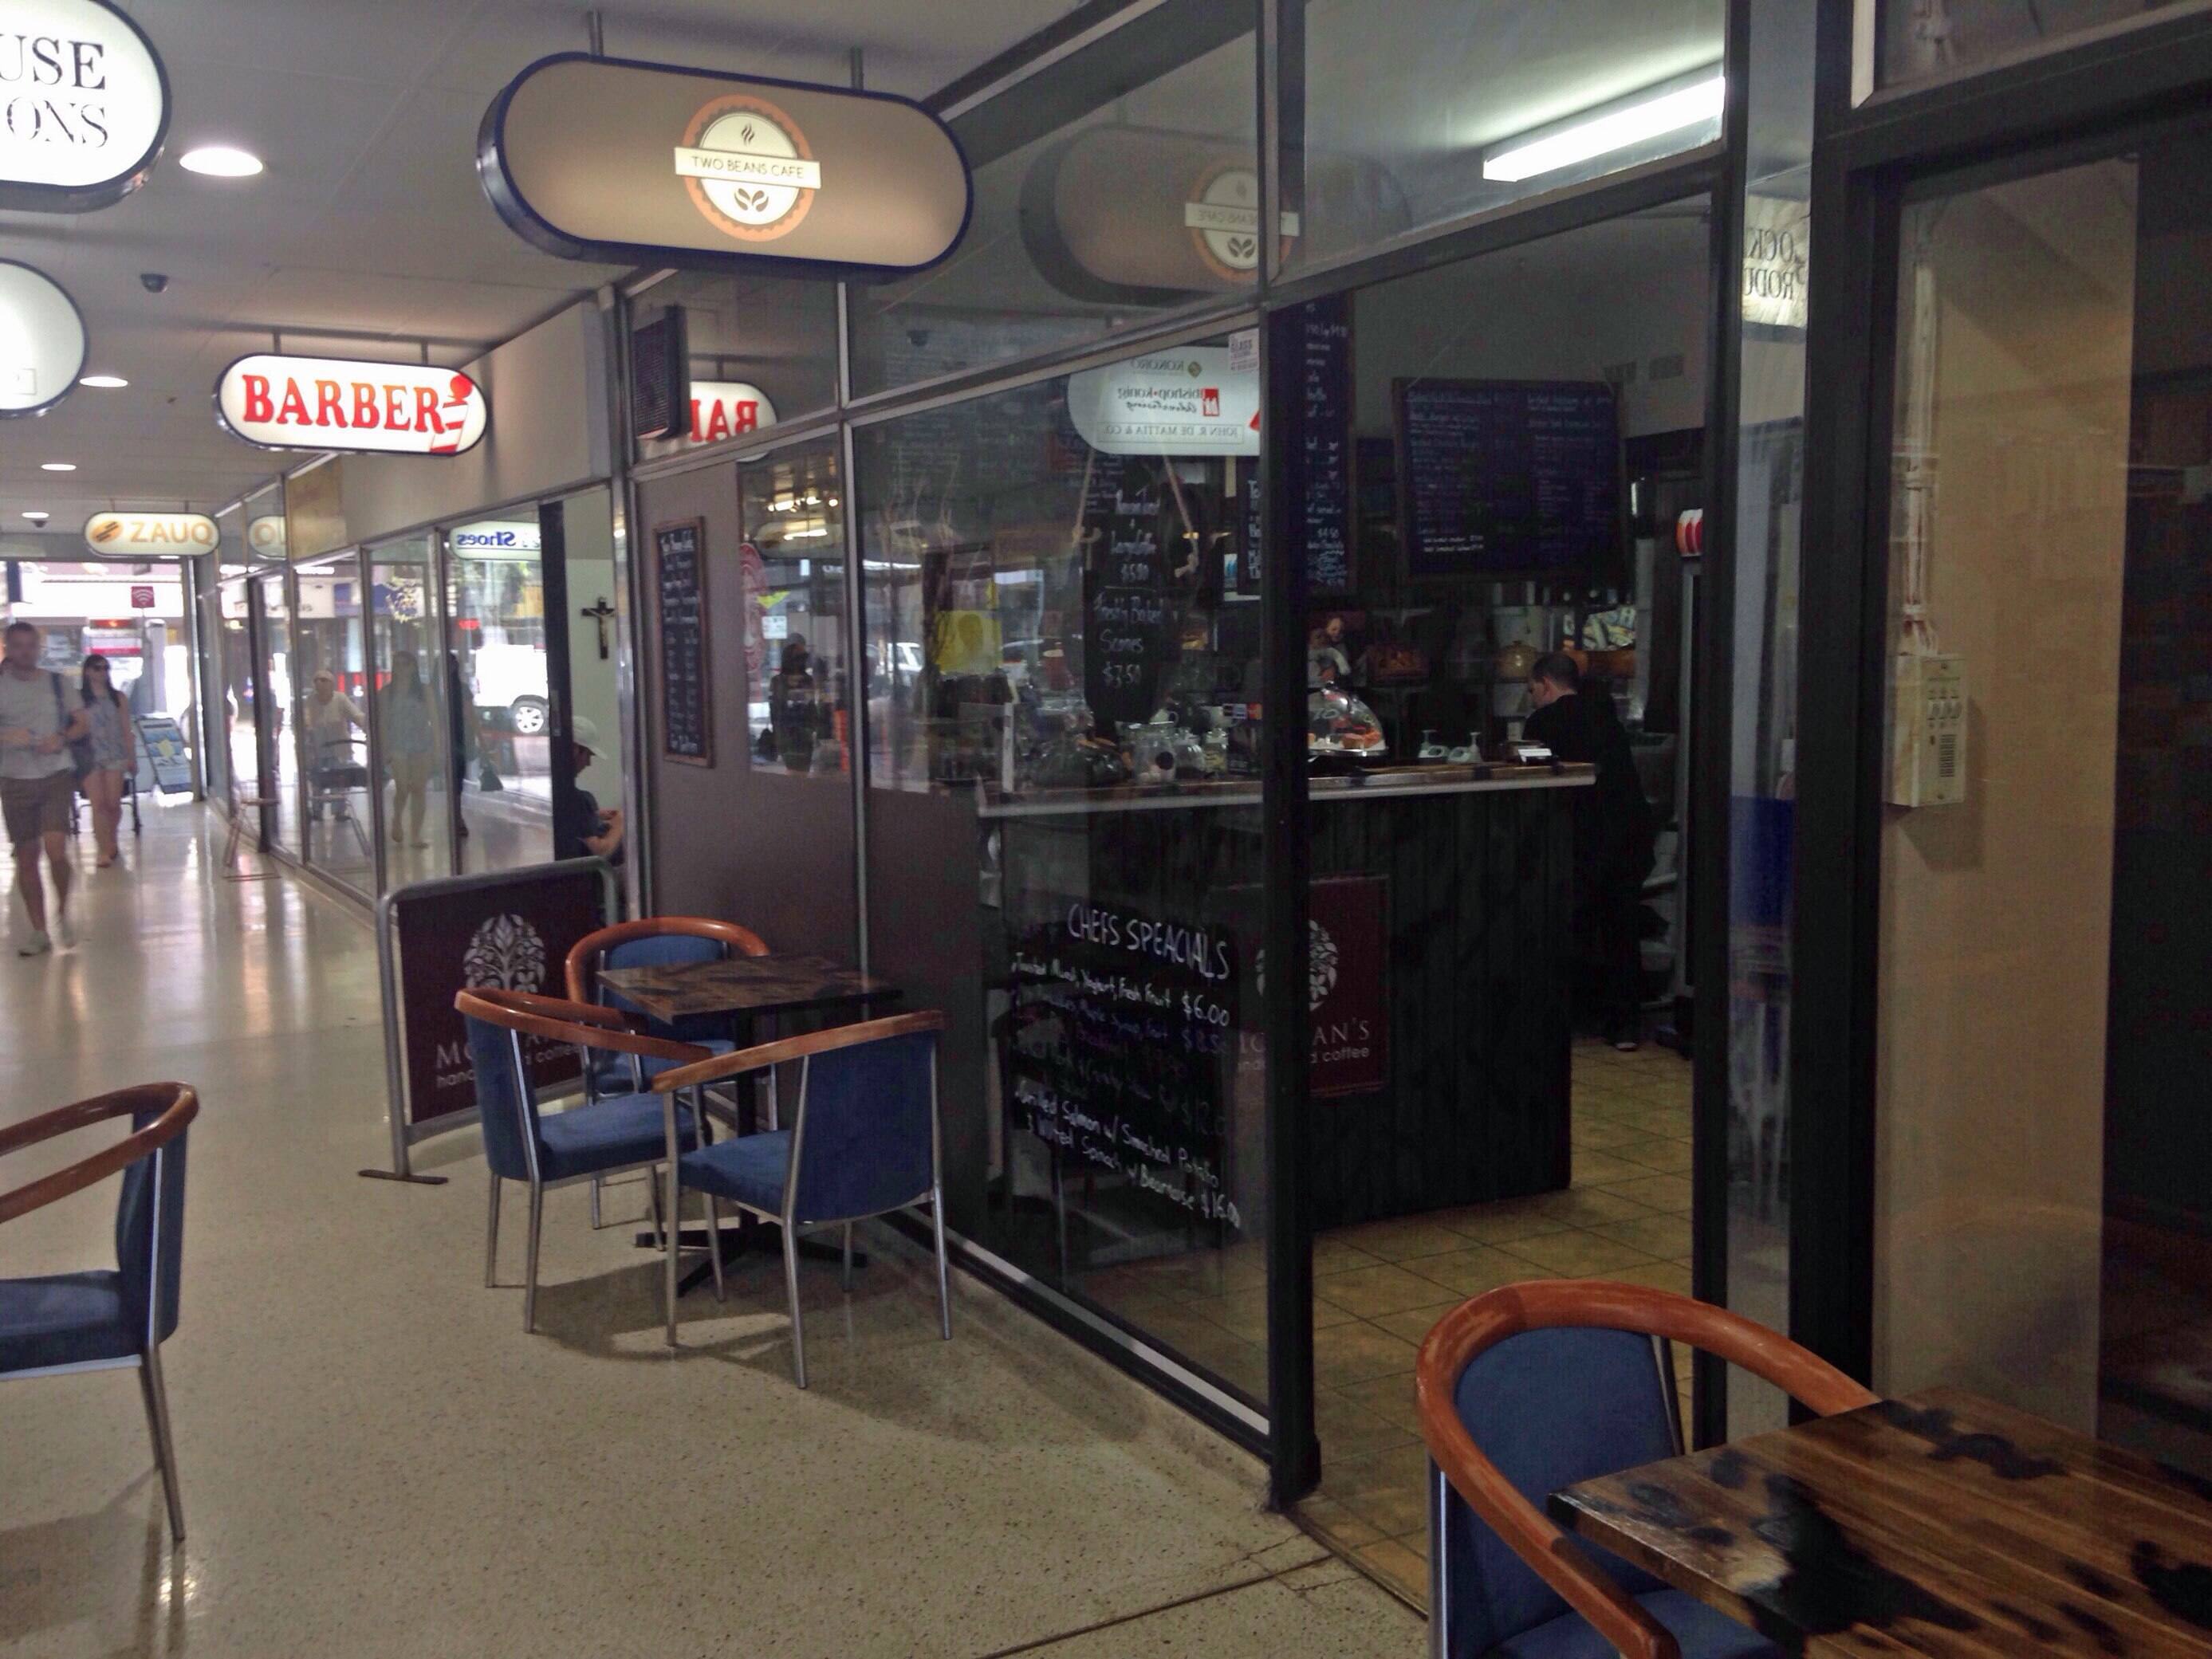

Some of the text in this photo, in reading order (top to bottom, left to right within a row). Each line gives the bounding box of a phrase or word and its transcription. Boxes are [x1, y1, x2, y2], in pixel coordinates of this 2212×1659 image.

[691, 155, 805, 179] TWO BEANS CAFE
[242, 374, 444, 434] BARBER
[130, 521, 215, 545] ZAUQ
[1067, 902, 1122, 946] CHEFS
[1322, 1046, 1371, 1063] coffee
